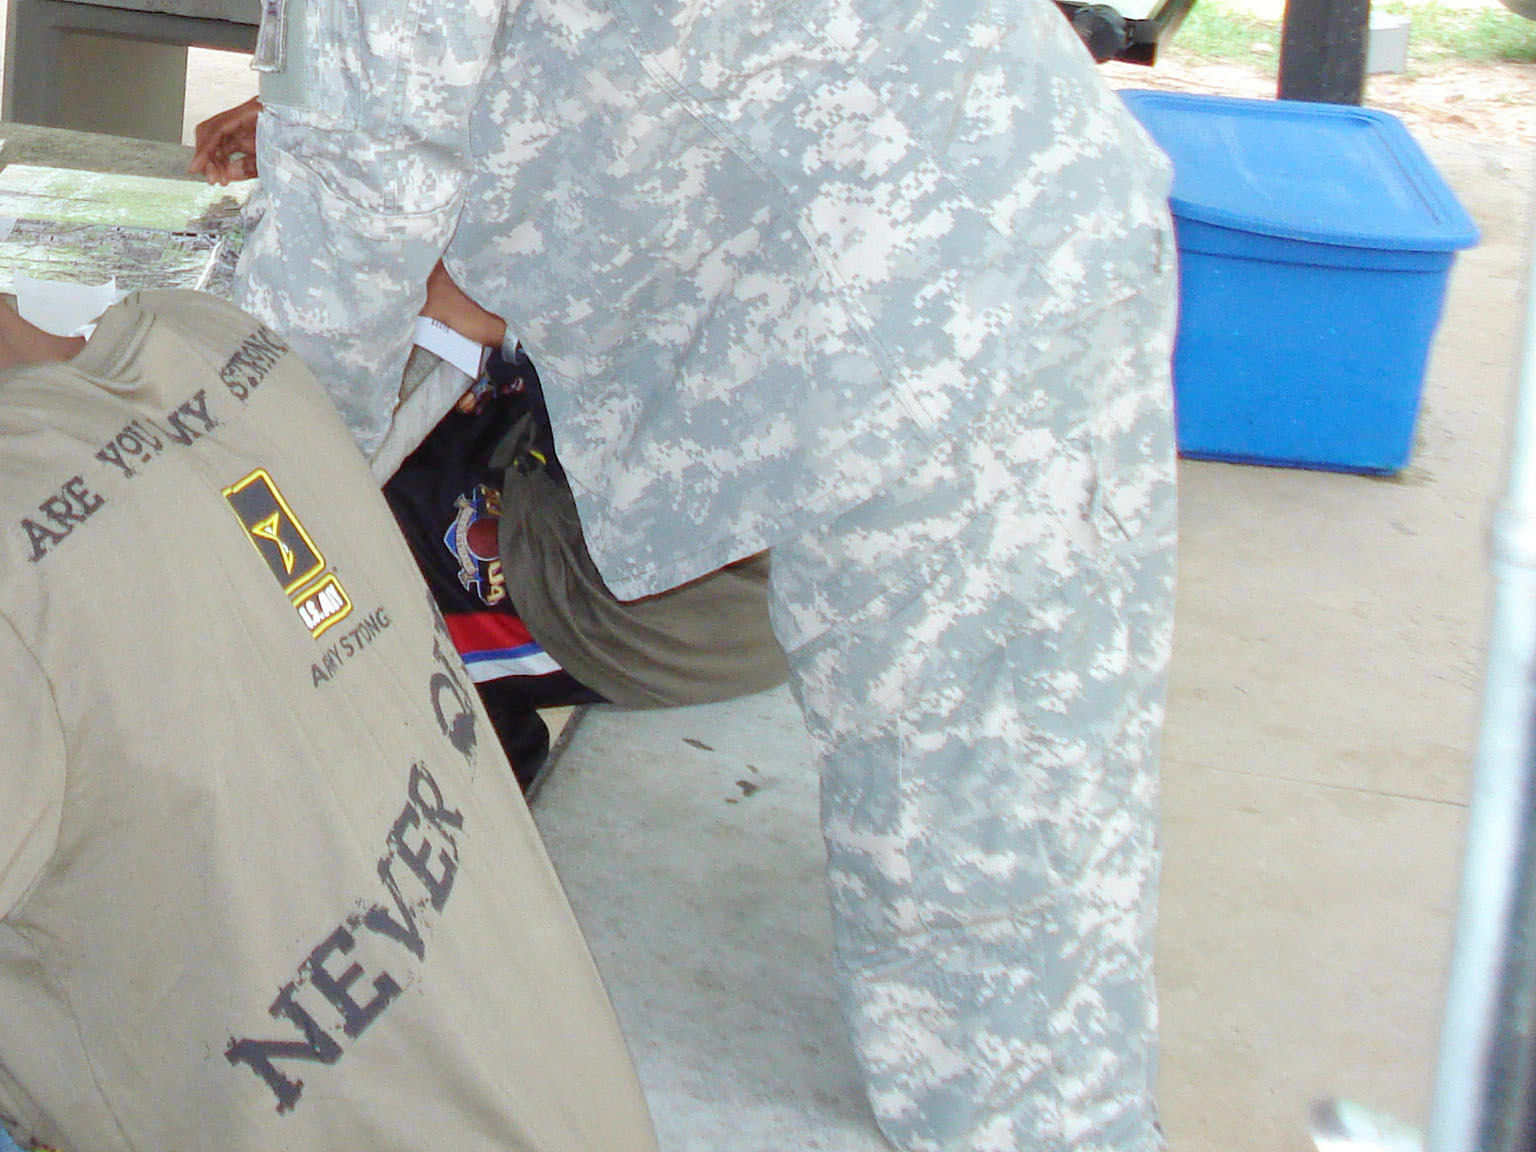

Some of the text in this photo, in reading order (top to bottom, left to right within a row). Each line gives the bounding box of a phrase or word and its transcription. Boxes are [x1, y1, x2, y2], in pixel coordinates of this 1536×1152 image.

[21, 475, 106, 563] ARE
[95, 419, 164, 479] YOU
[224, 759, 465, 1116] NEVER
